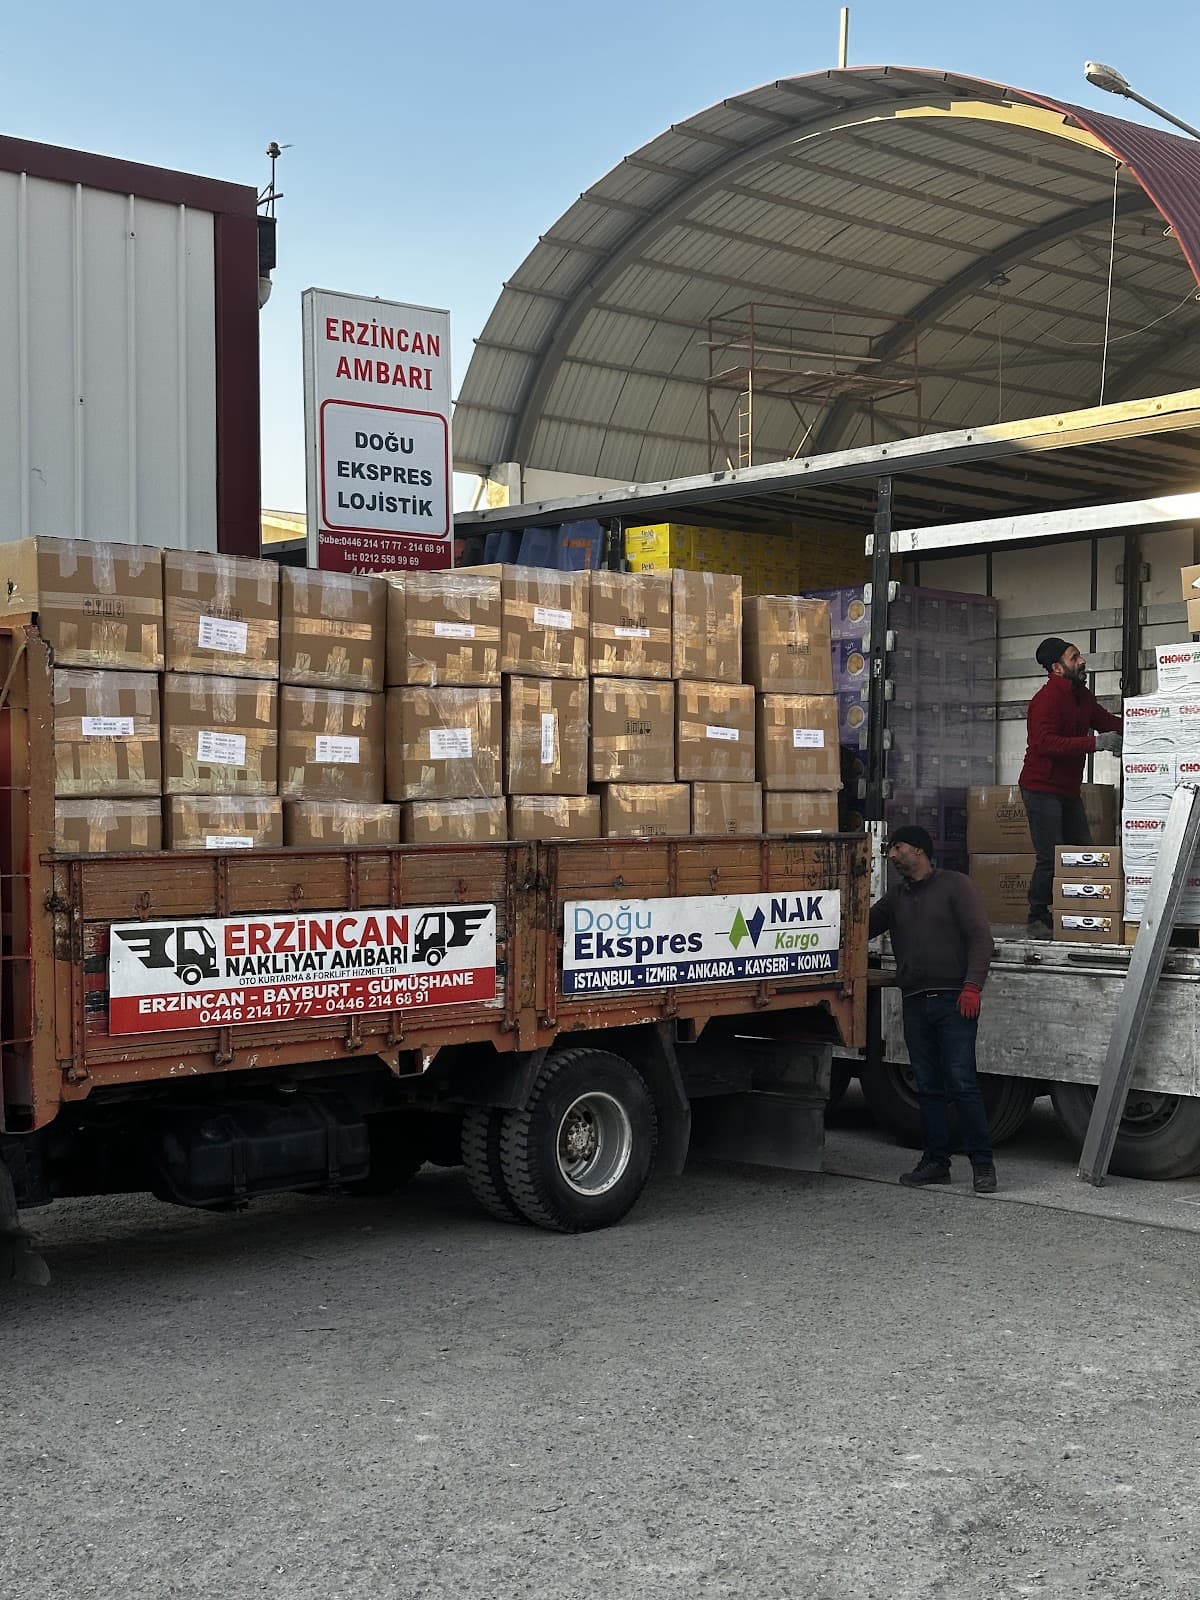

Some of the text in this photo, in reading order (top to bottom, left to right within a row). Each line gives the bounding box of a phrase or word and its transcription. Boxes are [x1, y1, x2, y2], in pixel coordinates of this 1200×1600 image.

[326, 317, 440, 357] ERZİNCAN
[336, 356, 433, 391] AMBARI
[355, 431, 414, 454] DOĞU
[337, 460, 433, 487] EKSPRES
[338, 491, 433, 517] LOJİSTİK
[359, 552, 379, 563] 0212
[381, 554, 396, 564] 558
[397, 556, 408, 565] 99
[409, 557, 420, 566] 69
[363, 538, 378, 548] 214
[381, 540, 391, 550] 17
[391, 541, 401, 550] 77
[408, 542, 423, 552] 214
[424, 544, 435, 553] 68
[437, 545, 445, 554] 91
[574, 905, 652, 937] Doğu
[770, 896, 824, 924] NAK
[574, 931, 703, 964] Ekspres
[775, 931, 820, 951] Kargo
[330, 945, 408, 970] AMBARI
[687, 961, 735, 980] ANKARA
[797, 953, 832, 971] KONYA
[239, 978, 257, 986] OTO
[259, 973, 304, 985] KURTARMA
[263, 983, 351, 1003] BAYBURT
[368, 972, 474, 994] GÜMÜŞHANE
[199, 1007, 242, 1023] 0446
[246, 1004, 272, 1019] 214
[276, 1003, 289, 1016] 17
[295, 1001, 313, 1015] 77
[325, 997, 365, 1011] 0446
[368, 995, 392, 1008] 214
[415, 990, 429, 1003] 91
